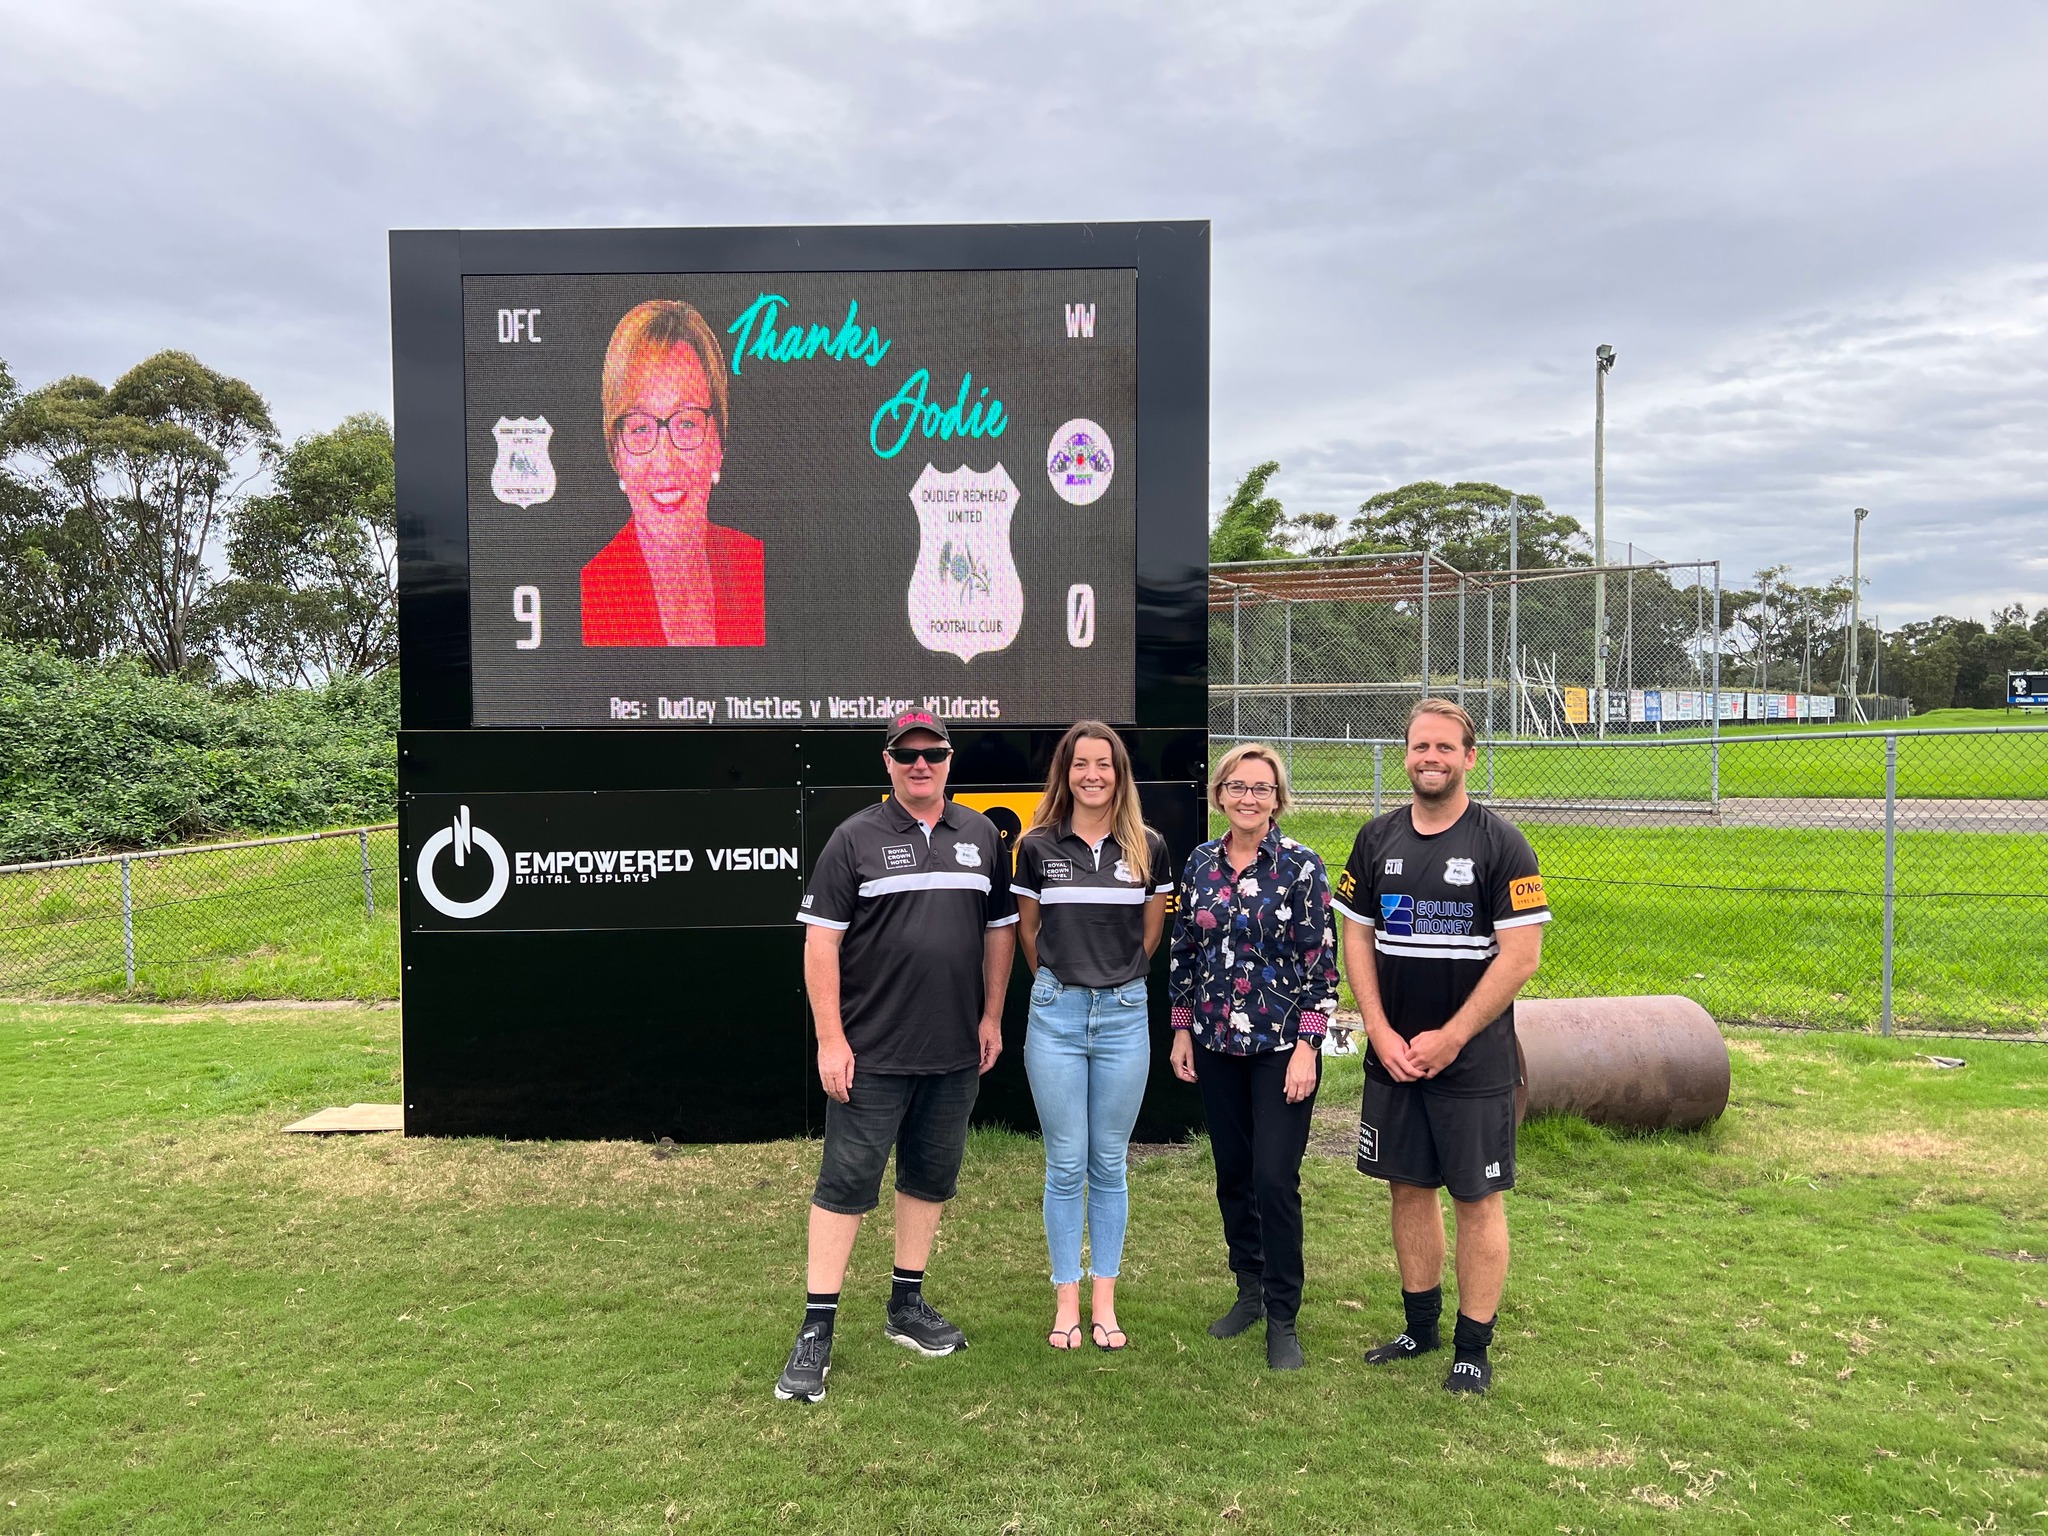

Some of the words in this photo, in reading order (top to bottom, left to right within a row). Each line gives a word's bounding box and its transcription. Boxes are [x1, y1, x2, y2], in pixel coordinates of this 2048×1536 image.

[498, 309, 541, 343] DFC
[728, 293, 891, 375] Thanks
[870, 368, 1008, 459] Jodie
[922, 490, 959, 502] DUDLEY
[963, 490, 1007, 502] REDHEAD
[948, 511, 982, 523] UNITED
[513, 586, 541, 649] 9
[930, 620, 976, 633] FOOTBALL
[978, 620, 1003, 633] CLUB
[610, 697, 648, 719] Res:
[725, 697, 802, 719] Thistles
[809, 699, 822, 718] v
[515, 849, 694, 878] EMPOWERED
[705, 847, 798, 871] VISION
[516, 875, 572, 884] DIGITAL
[579, 873, 650, 884] DISPLAYS
[1416, 901, 1474, 918] EQUIUS
[1415, 918, 1473, 935] MONEY
